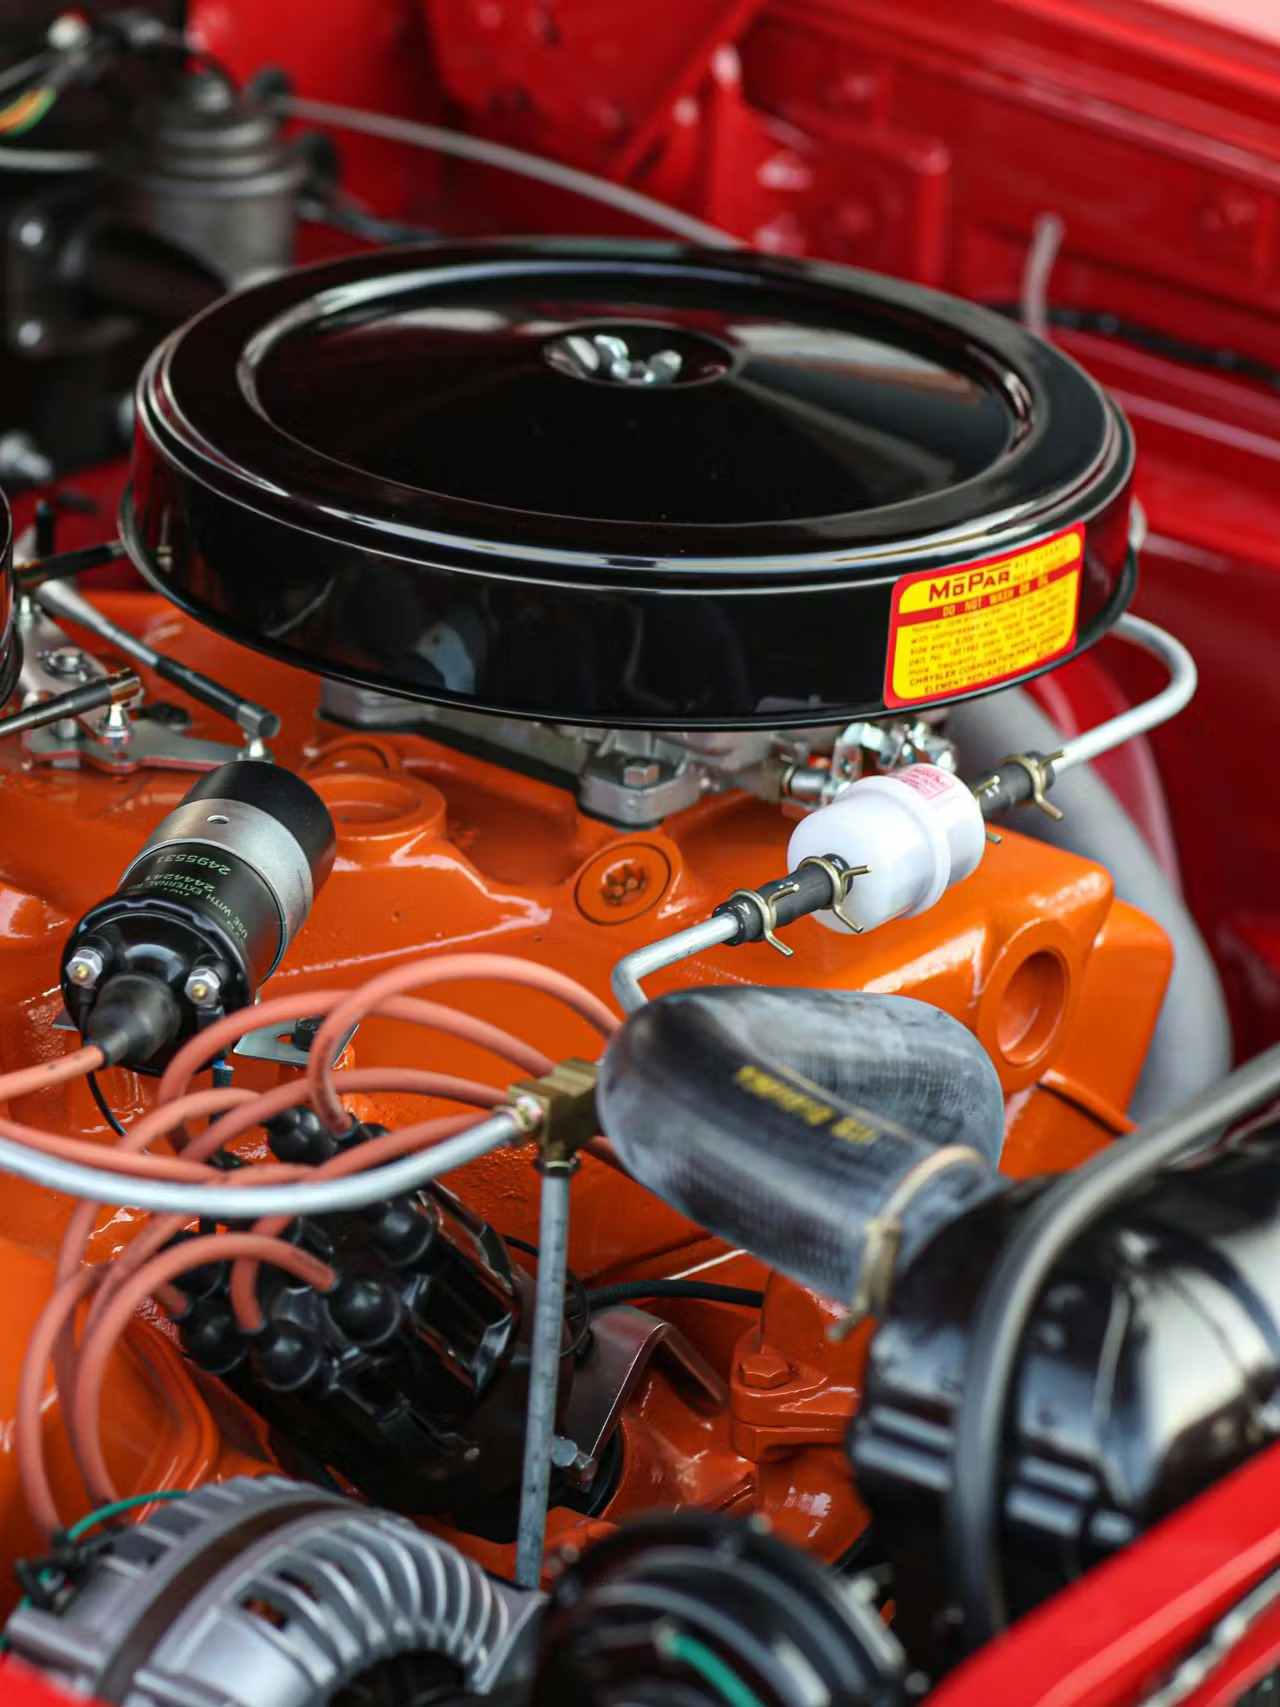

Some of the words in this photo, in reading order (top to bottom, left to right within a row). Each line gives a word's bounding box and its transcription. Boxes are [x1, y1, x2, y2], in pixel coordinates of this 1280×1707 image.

[943, 604, 955, 618] DO
[965, 598, 981, 612] NOT
[154, 853, 233, 876] 2495531
[148, 880, 204, 896] EXTERNAL
[205, 893, 233, 917] WITH
[231, 916, 249, 940] USE
